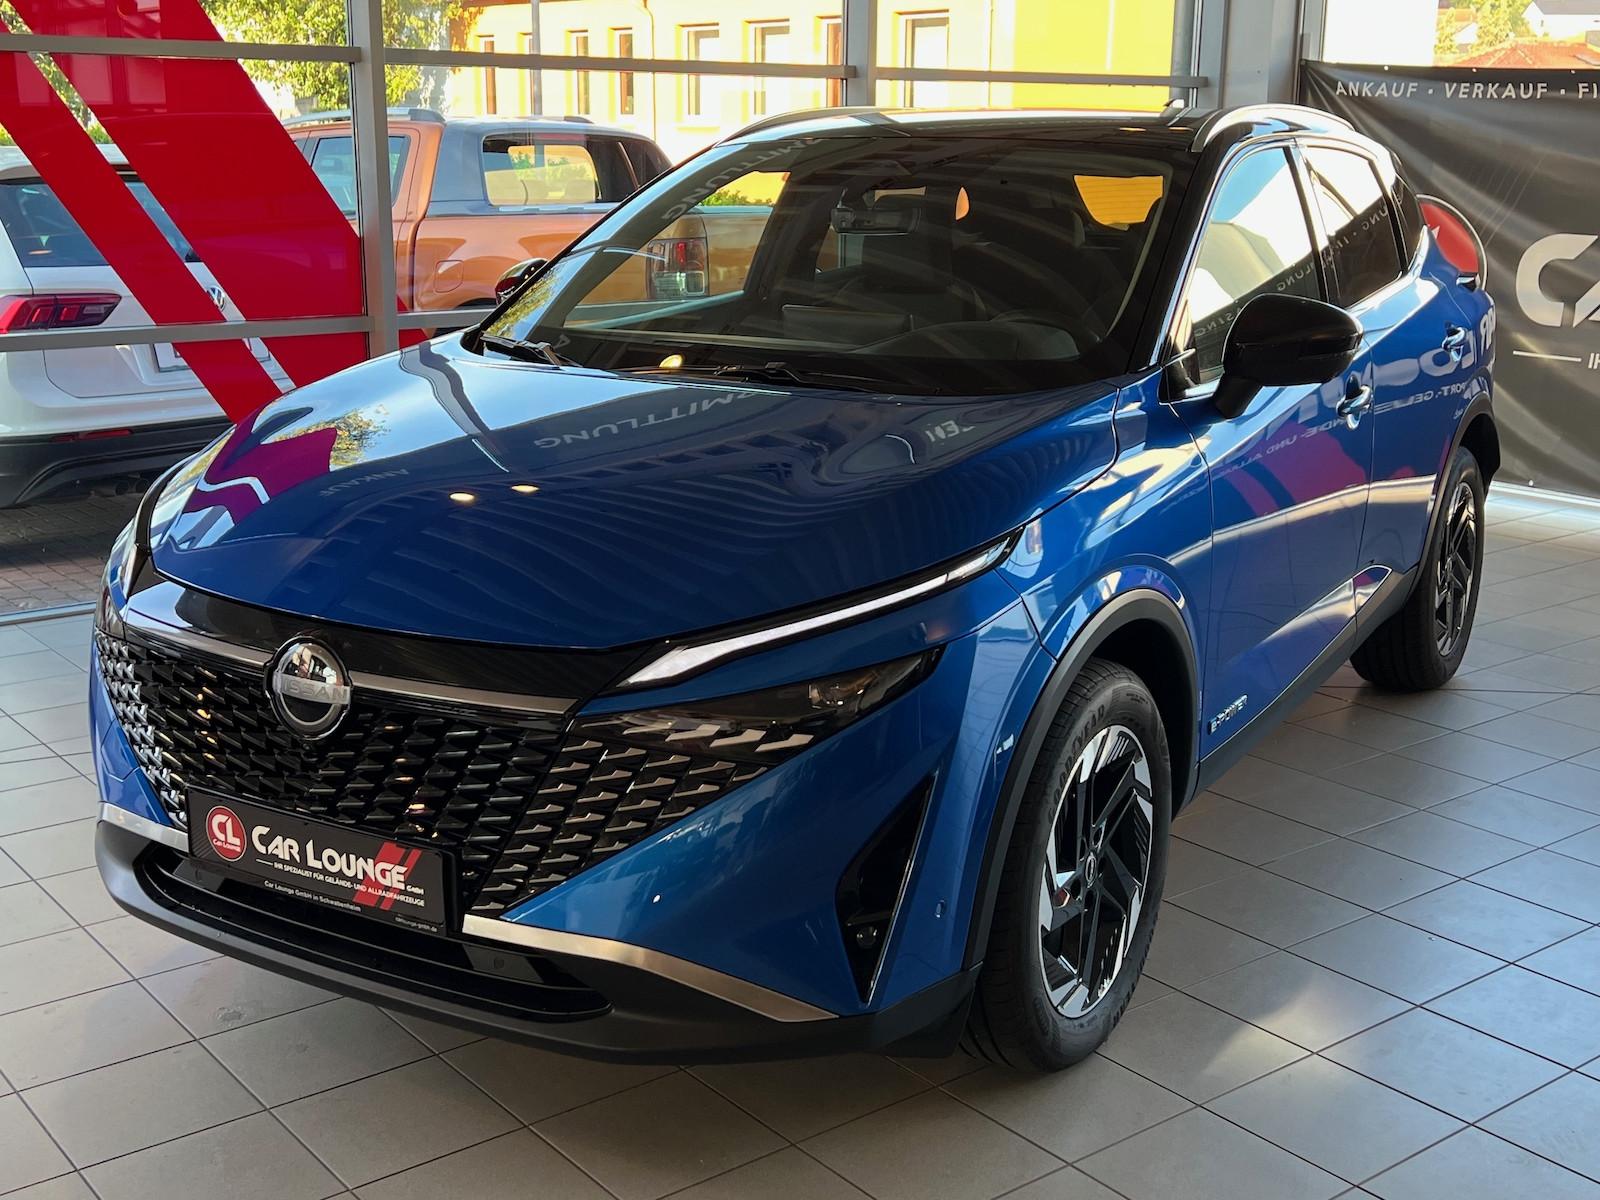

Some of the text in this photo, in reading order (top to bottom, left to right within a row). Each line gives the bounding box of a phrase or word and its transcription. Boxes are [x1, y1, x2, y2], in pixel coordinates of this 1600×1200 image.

[1336, 81, 1418, 98] ANKAUF
[1444, 82, 1548, 99] VERKAUF
[211, 813, 241, 847] CL
[283, 864, 313, 878] SPEZIALIST
